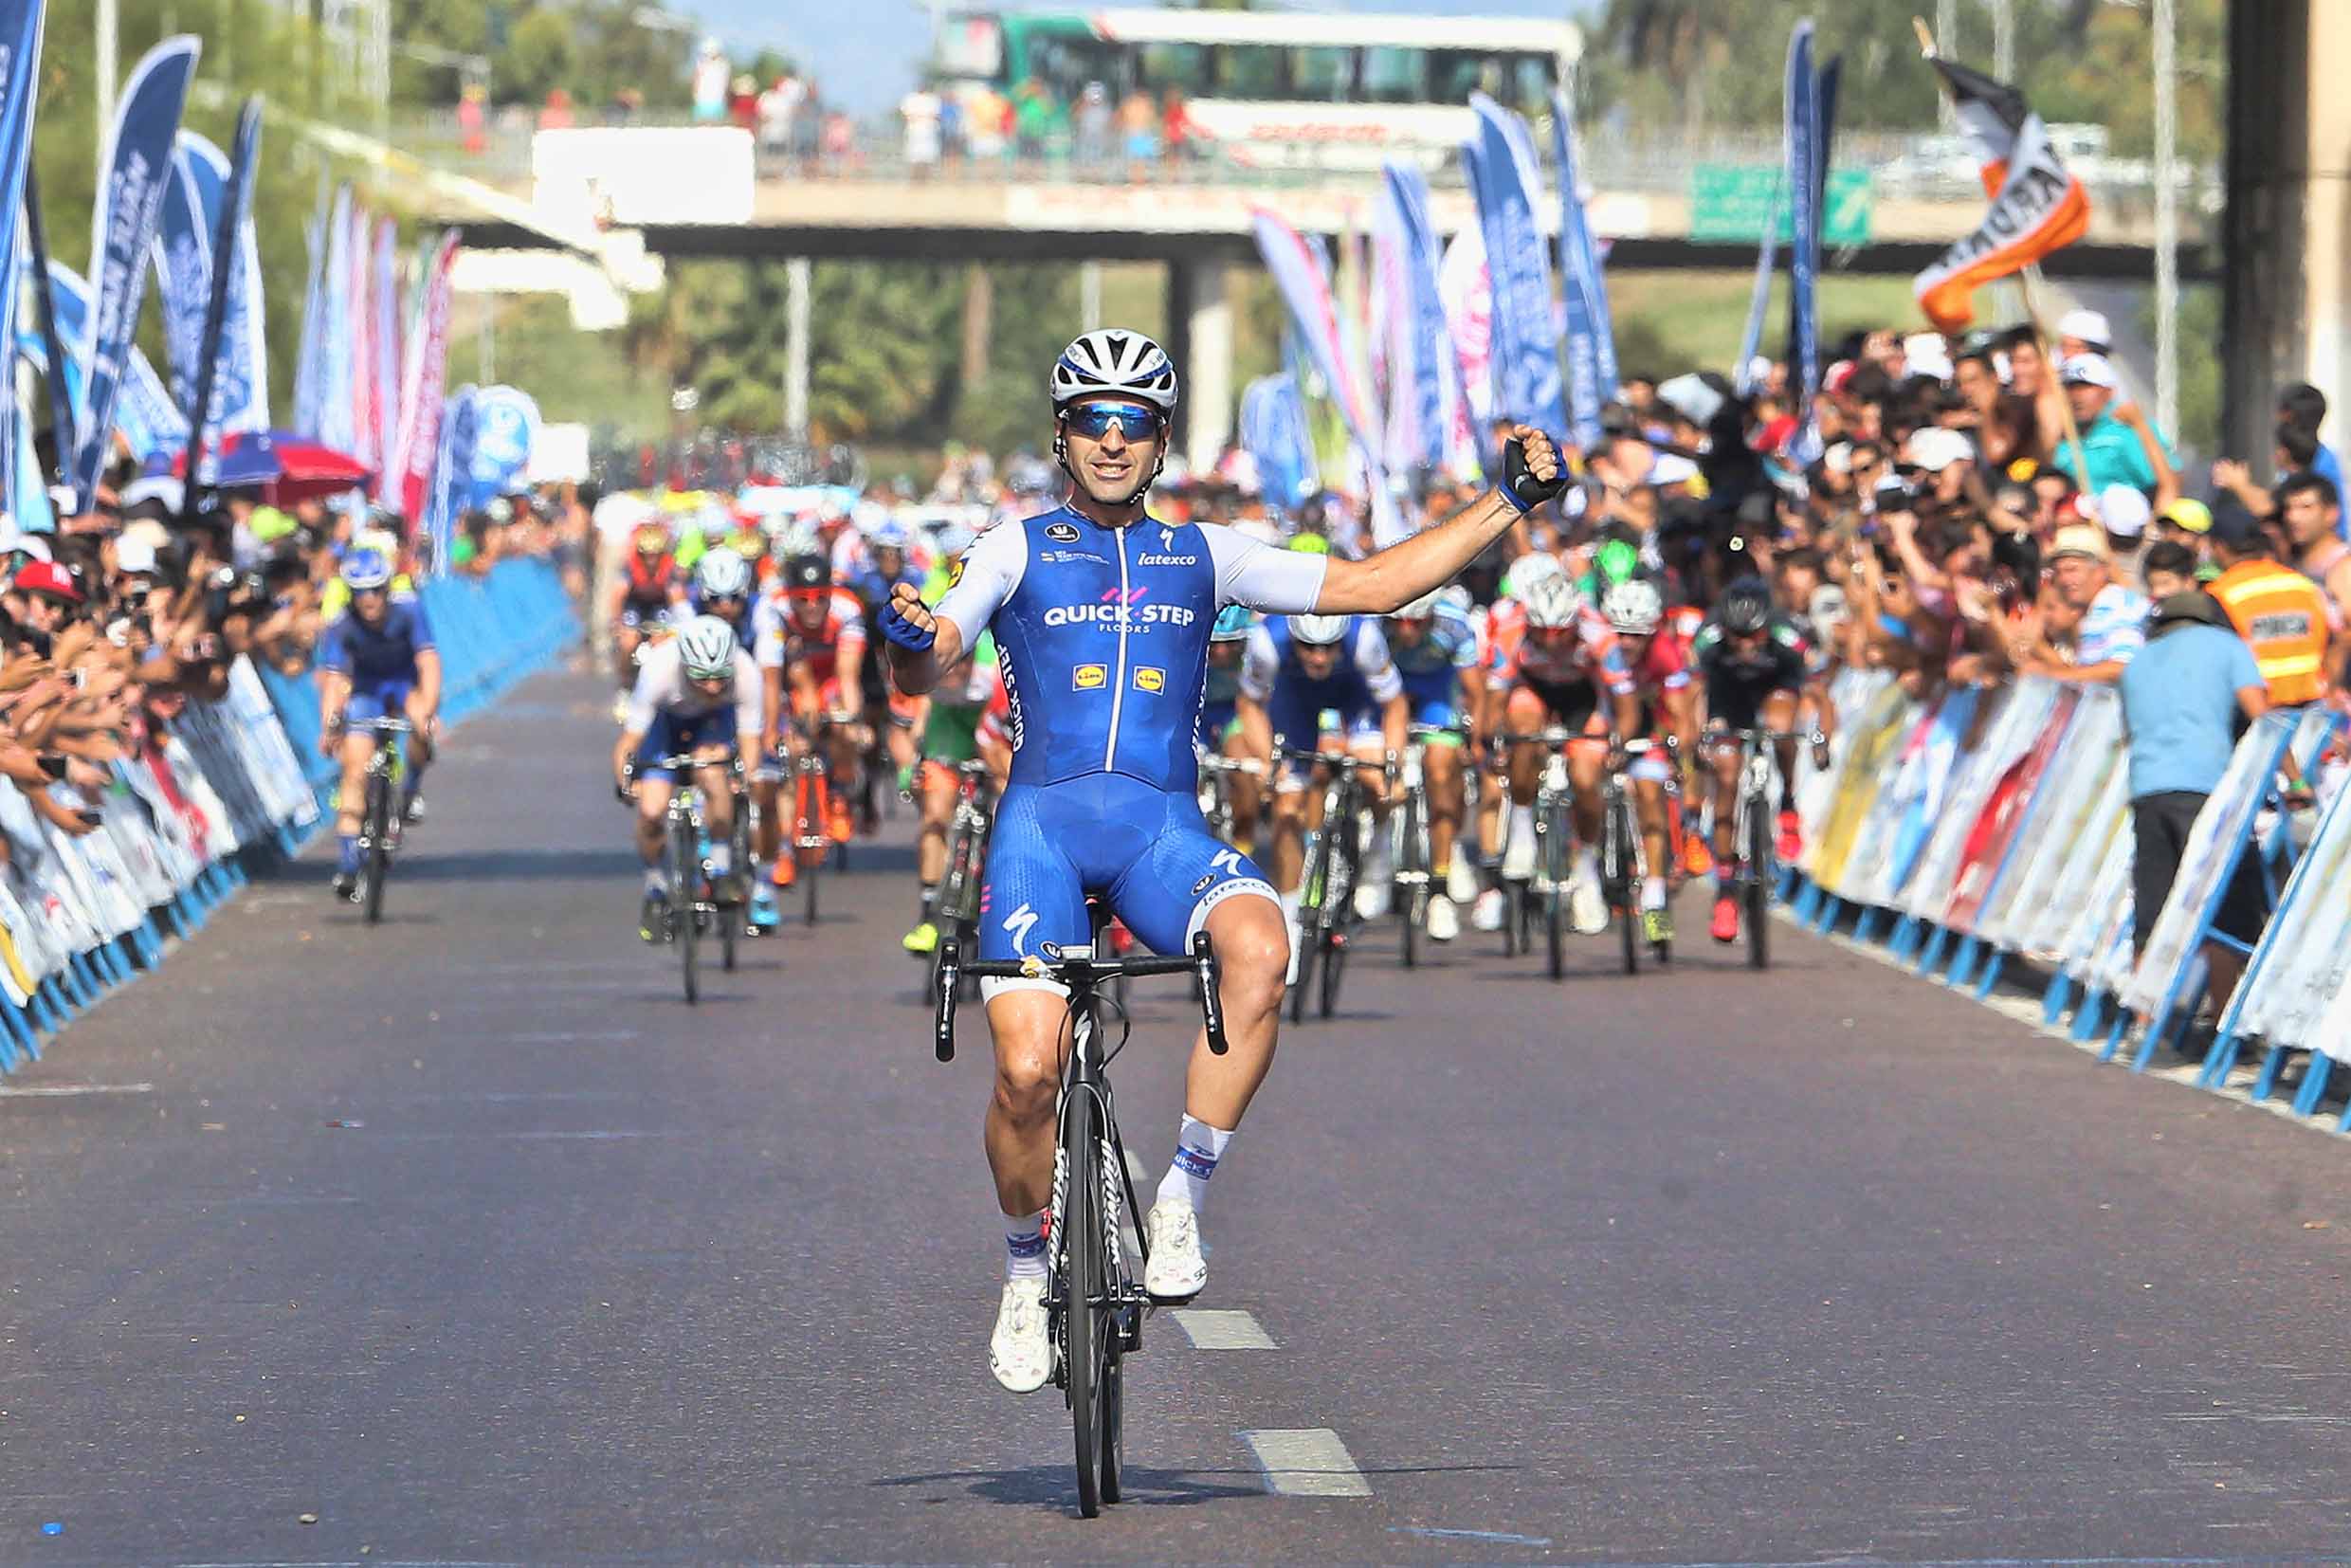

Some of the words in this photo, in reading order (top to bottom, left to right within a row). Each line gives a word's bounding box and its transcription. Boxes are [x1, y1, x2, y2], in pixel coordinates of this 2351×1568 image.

[1138, 553, 1196, 566] latexco
[1044, 605, 1134, 626] QUICK
[1141, 605, 1195, 627] STEP
[1099, 624, 1151, 633] FLOORS
[1011, 690, 1025, 753] QUICK
